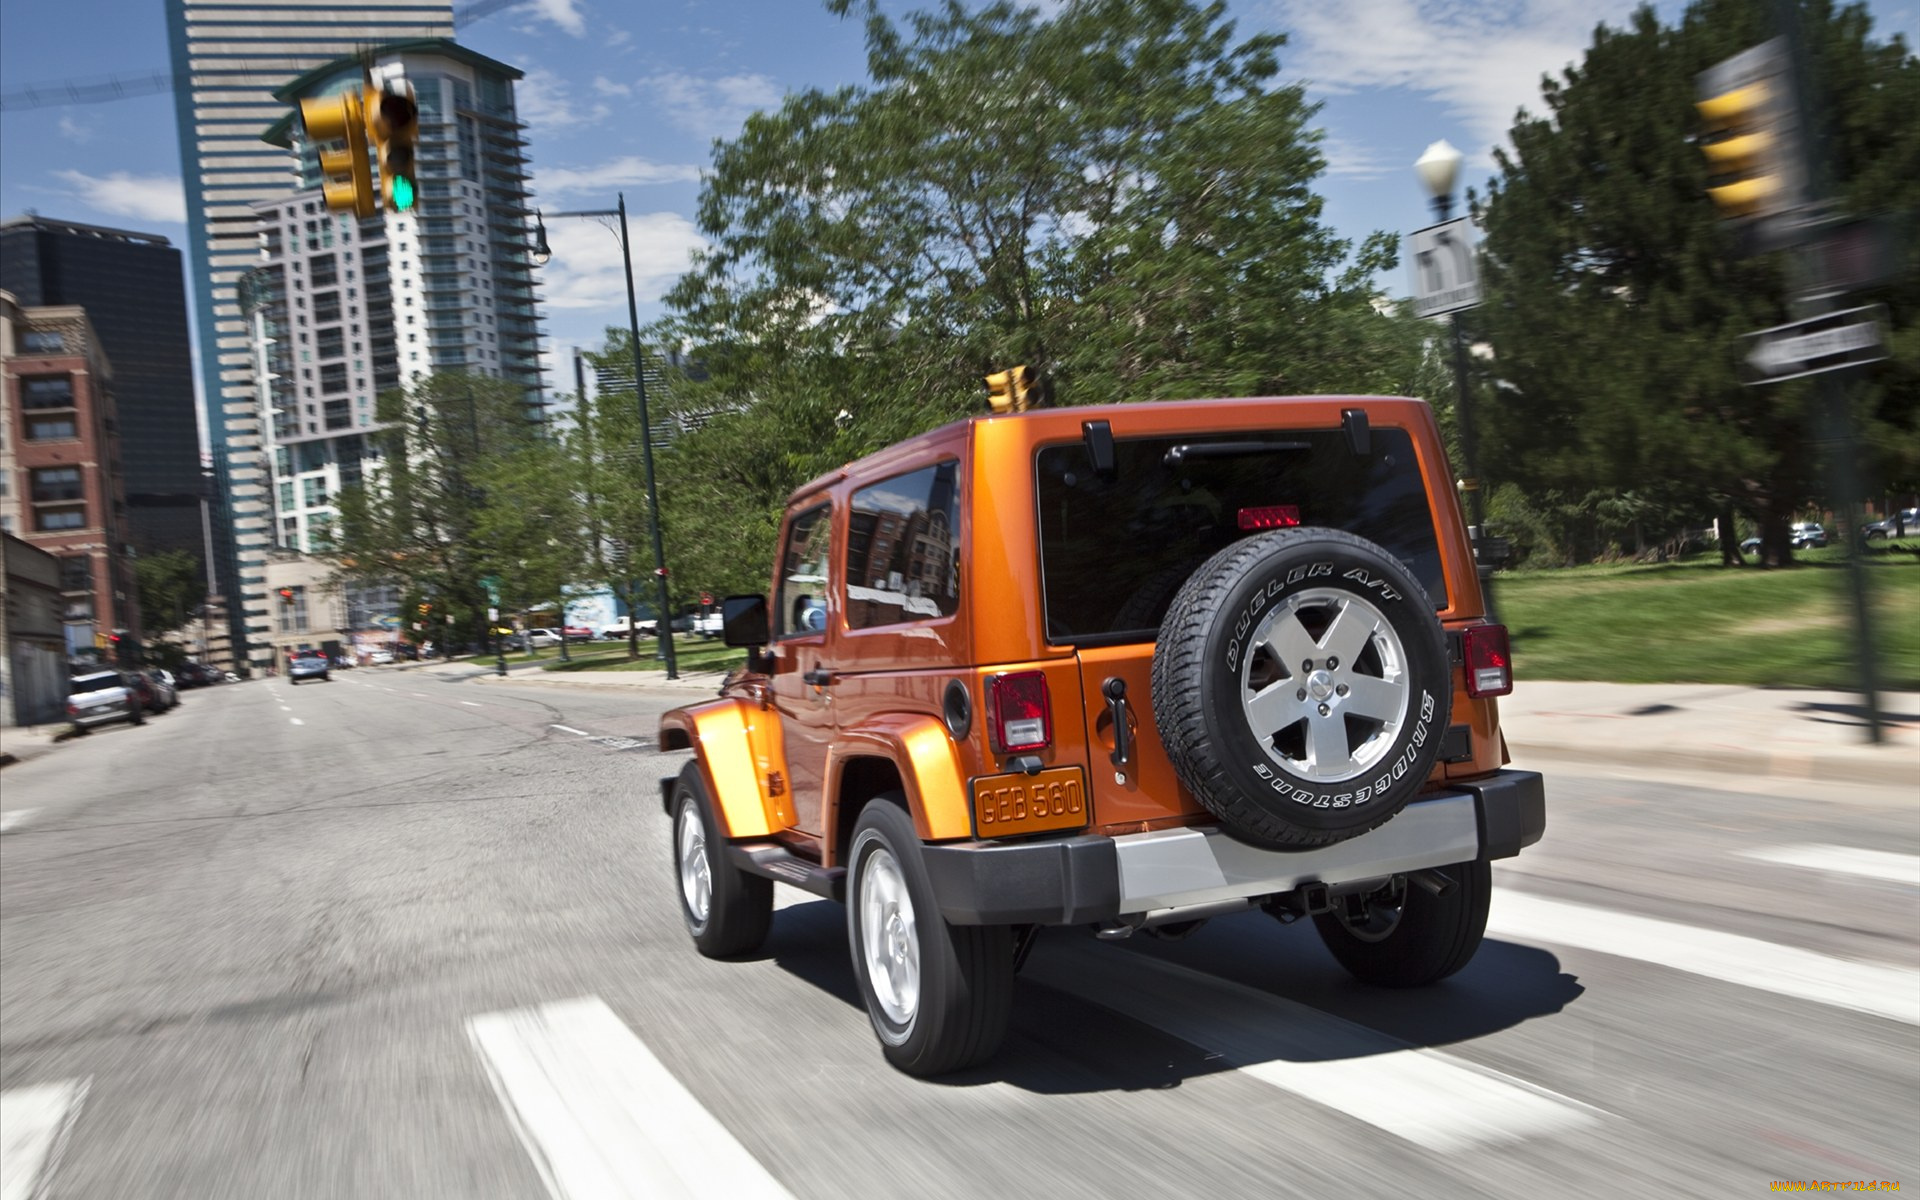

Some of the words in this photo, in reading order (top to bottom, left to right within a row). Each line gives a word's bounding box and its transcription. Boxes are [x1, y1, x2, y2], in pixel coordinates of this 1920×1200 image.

[1226, 561, 1335, 673] DUELER
[1343, 567, 1402, 602] A/T
[979, 788, 1028, 825] GEB
[1031, 779, 1083, 818] 560
[1253, 689, 1435, 808] BRIDGESTONE
